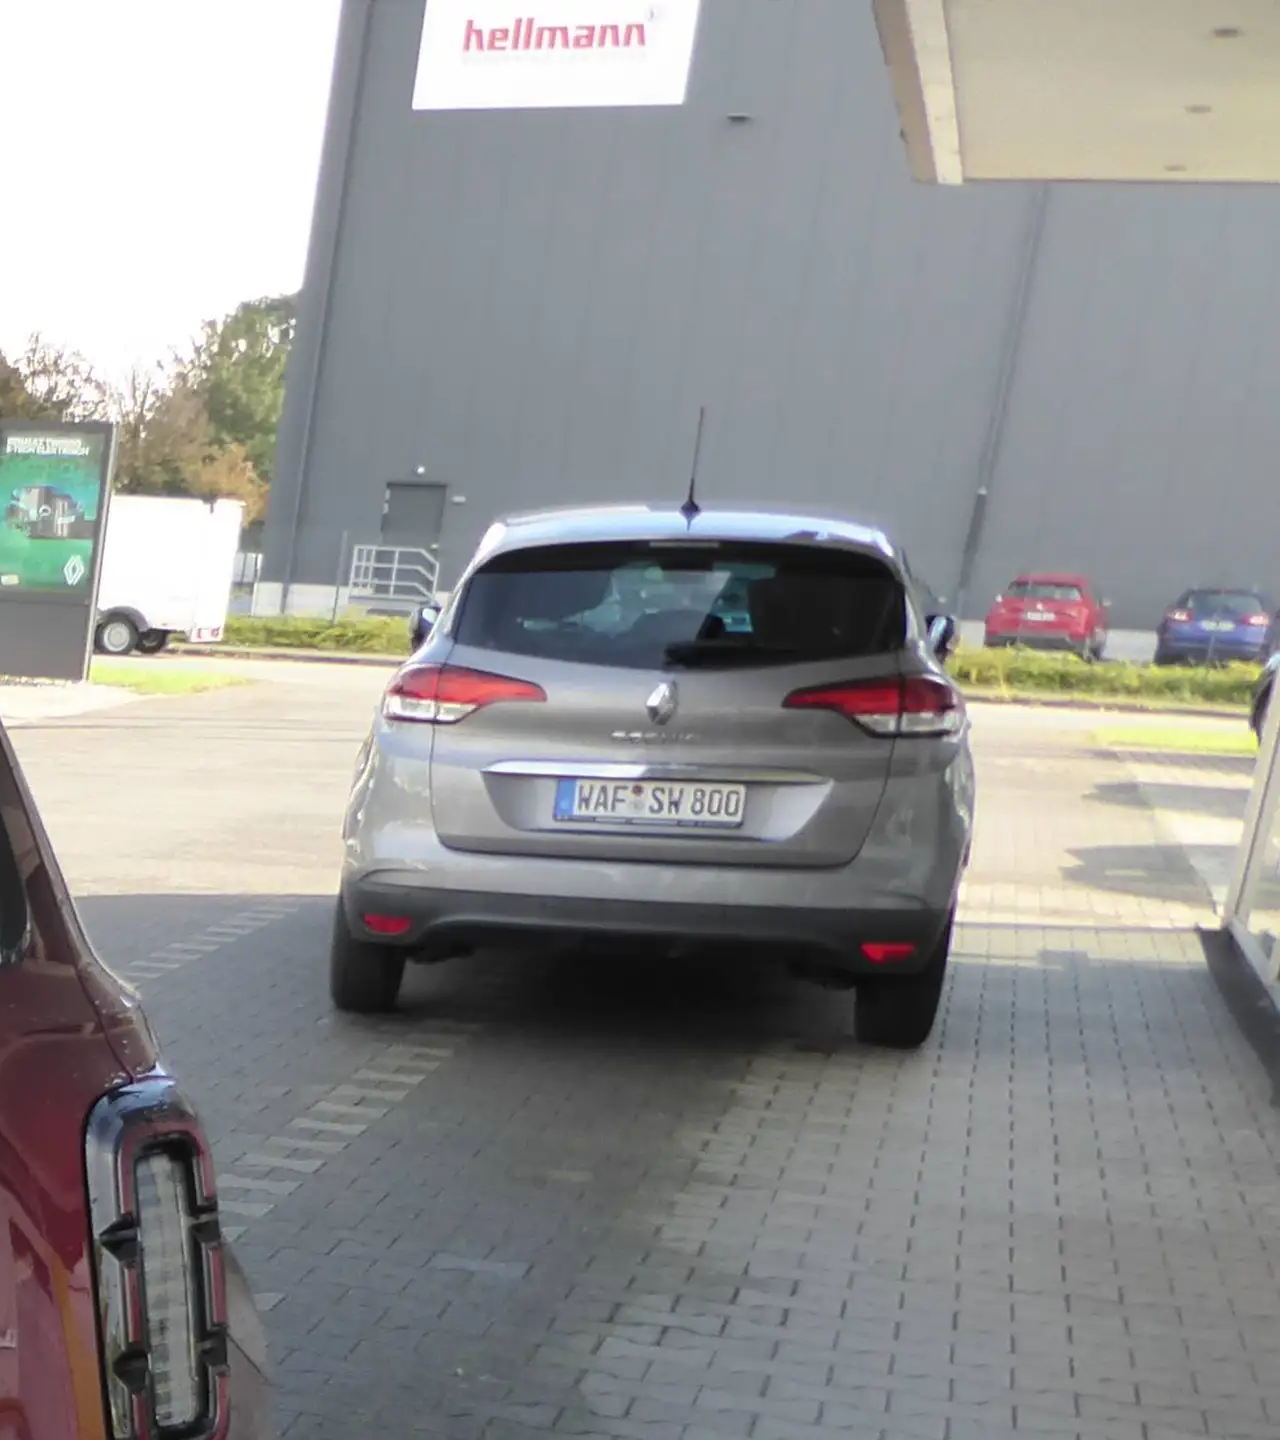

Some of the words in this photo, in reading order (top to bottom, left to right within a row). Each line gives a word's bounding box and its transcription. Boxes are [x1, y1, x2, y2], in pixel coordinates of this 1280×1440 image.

[462, 17, 645, 51] hellmann
[577, 784, 628, 813] WAF
[649, 787, 683, 815] SW
[691, 788, 739, 817] 800
